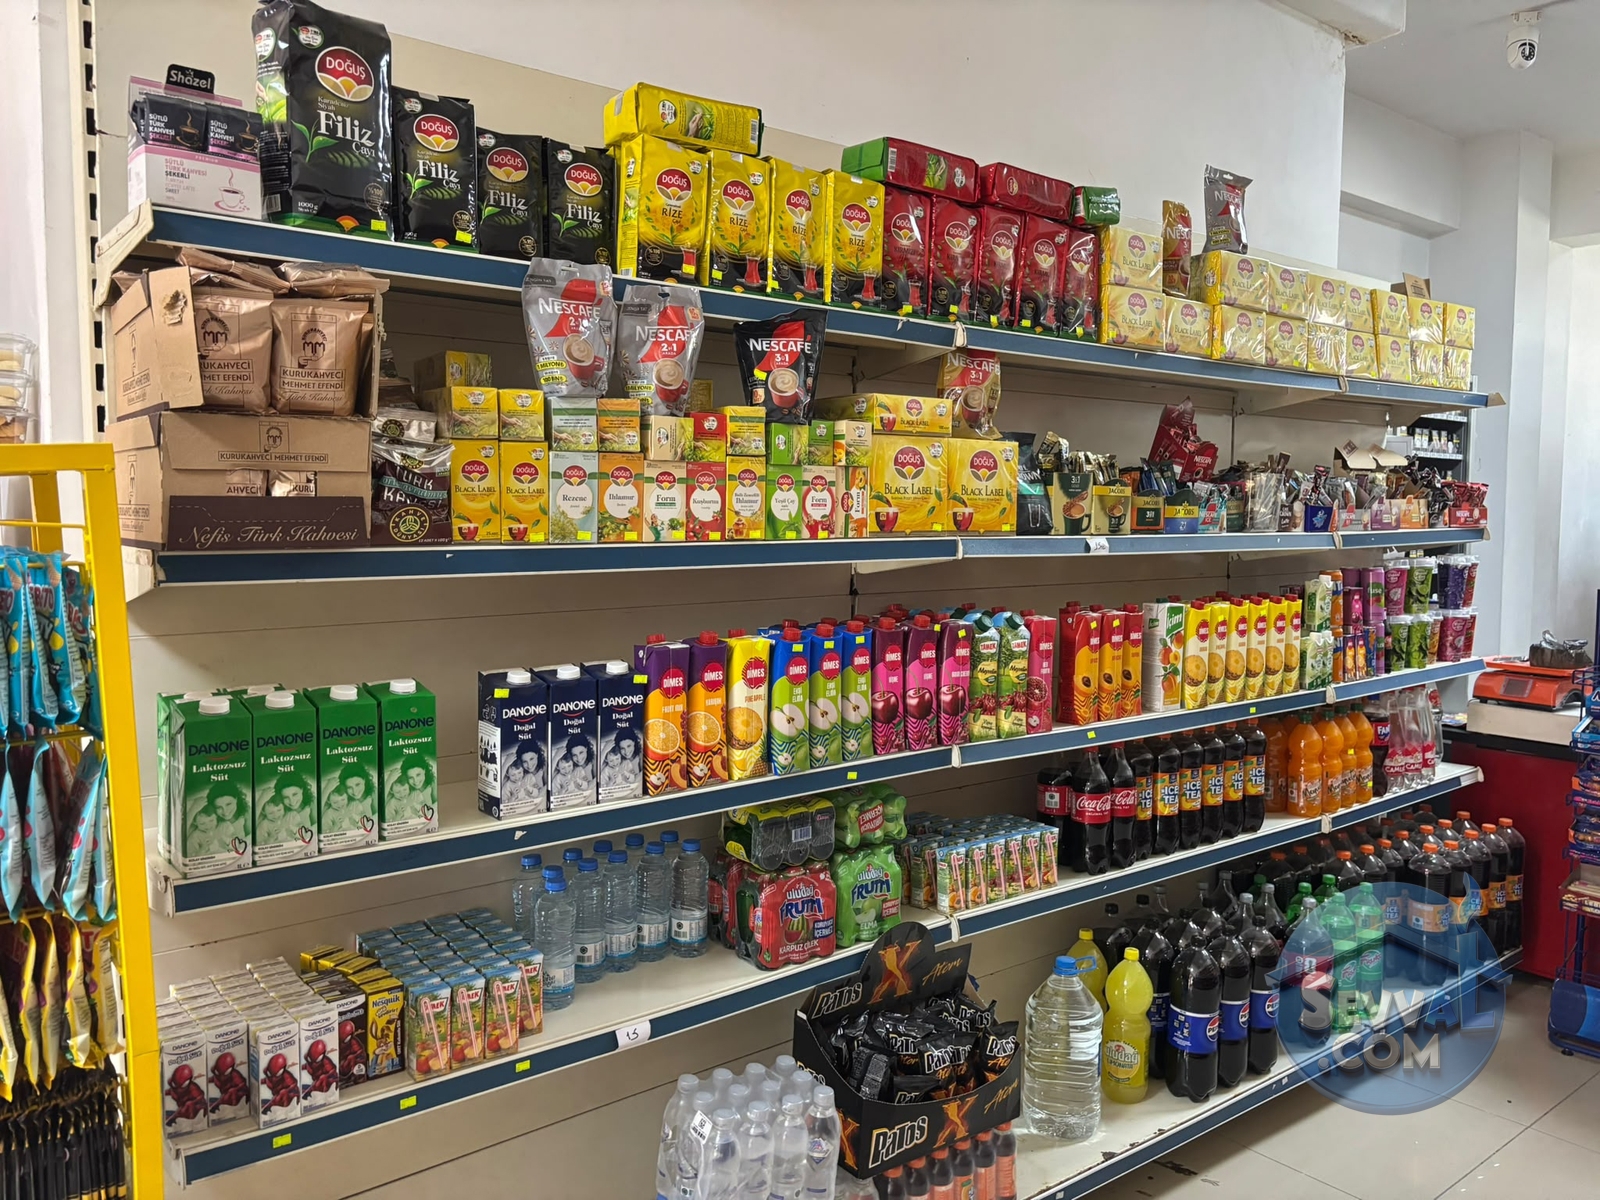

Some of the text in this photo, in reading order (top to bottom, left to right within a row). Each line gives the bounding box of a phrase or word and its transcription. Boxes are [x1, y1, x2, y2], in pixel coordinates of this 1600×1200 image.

[325, 55, 366, 80] DOĞUŞ
[170, 69, 211, 90] Shazel
[149, 113, 168, 122] SÜTLÜ
[149, 120, 165, 128] TÜRK
[210, 120, 227, 129] SÜTLÜ
[317, 110, 376, 147] Filiz
[420, 120, 453, 135] DOĞUŞ
[149, 126, 175, 136] KAHVESİ
[210, 126, 225, 135] TÜRK
[210, 131, 234, 142] KAHVESİ
[352, 141, 376, 158] Çayı
[165, 158, 184, 166] SÜTLÜ
[493, 154, 522, 167] DOĞUŞ
[165, 165, 207, 176] TÜRK KAHVESİ
[165, 171, 190, 179] ŞEKERLİ
[417, 159, 460, 183] Filiz
[570, 168, 598, 182] DOĞUŞ
[443, 179, 461, 190] Çayı
[661, 174, 688, 189] DOĞUŞ
[727, 185, 751, 198] DOĞUŞ
[488, 189, 529, 211] Filiz
[790, 194, 809, 208] DOĞUŞ
[510, 208, 528, 217] Çayı
[566, 202, 603, 223] Filiz
[661, 207, 683, 219] RİZE
[845, 209, 867, 220] DOĞUŞ
[587, 220, 603, 229] Çayı
[729, 216, 748, 227] RİZE
[949, 227, 969, 238] DOĞUŞ
[849, 237, 865, 248] RİZE
[538, 297, 603, 319] NESCAFÉ
[749, 335, 813, 354] NESCAFÉ
[201, 361, 251, 370] UKAHVECİ
[223, 373, 252, 382] EFENDİ
[282, 369, 344, 380] KURUKAHVECİ
[282, 380, 344, 390] MEHMET EFENDİ
[900, 418, 930, 427] BLACK LABEL
[220, 452, 328, 463] KURUKAHVECİ MEHMET EFENDİ
[897, 453, 921, 465] DOĞUŞ
[973, 457, 995, 468] DOĞUŞ
[464, 463, 486, 473] DOĞUŞ
[515, 466, 536, 475] DOĞUŞ
[566, 468, 585, 478] DOĞUŞ
[612, 469, 631, 478] DOĞUŞ
[658, 474, 675, 483] DOĞUŞ
[697, 475, 715, 484] DOĞUŞ
[739, 472, 755, 481] DOĞUŞ
[777, 477, 793, 486] DOĞUŞ
[226, 484, 260, 494] AHVECİ
[455, 485, 497, 493] BLACK LABEL
[506, 486, 546, 495] BLACK LABEL
[884, 482, 934, 496] BLACK LABEL
[961, 485, 1006, 498] BLACK LABEL
[1108, 487, 1126, 495] JACOBS
[562, 494, 588, 502] Rezene
[608, 492, 635, 502] Ihlamur
[656, 494, 676, 502] Form
[811, 496, 828, 504] Form
[178, 525, 359, 548] Nefis Türk Kahvesi
[955, 645, 970, 657] DİMES
[980, 641, 998, 652] TAMEK
[1039, 642, 1053, 651] DİMES
[885, 651, 901, 663] DİMES
[921, 648, 936, 659] DİMES
[822, 658, 840, 671] DİMES
[854, 653, 870, 666] DİMES
[746, 667, 765, 679] DİMES
[789, 663, 807, 676] DİMES
[703, 669, 723, 682] DİMES
[663, 676, 683, 688] DİMES
[602, 693, 644, 707] DANONE
[502, 703, 547, 718] DANONE
[553, 699, 596, 714] DANONE
[612, 711, 634, 722] Doğal
[385, 715, 434, 733] DANONE
[513, 722, 536, 733] Doğal
[563, 717, 585, 728] Doğal
[616, 720, 629, 729] Süt
[322, 723, 376, 741] DANONE
[518, 731, 532, 741] Süt
[567, 726, 581, 735] Süt
[256, 731, 314, 749] DANONE
[388, 734, 433, 748] Laktozsuz
[188, 739, 249, 757] DANONE
[326, 744, 373, 756] Laktozsuz
[402, 745, 418, 755] Süt
[260, 752, 312, 765] Laktozsuz
[341, 753, 358, 764] Süt
[192, 760, 247, 774] Laktozsuz
[277, 763, 295, 774] Süt
[1251, 767, 1265, 776] ICE
[210, 773, 229, 782] Süt
[1211, 778, 1224, 787] ICE
[1163, 786, 1180, 795] ICE
[1185, 781, 1201, 790] ICE
[1076, 795, 1111, 812] Coca-Cola
[857, 868, 883, 881] uludağ
[786, 884, 815, 900] uludağ
[861, 921, 878, 930] ELMA
[779, 943, 804, 955] KARPUZ
[803, 940, 819, 951] ÇİLEK
[923, 957, 963, 985] Atom
[372, 994, 400, 1008] Nesquik
[308, 1016, 331, 1027] DANONE
[215, 1029, 240, 1039] DANONE
[268, 1030, 292, 1041] DANONE
[172, 1041, 198, 1051] DANONE
